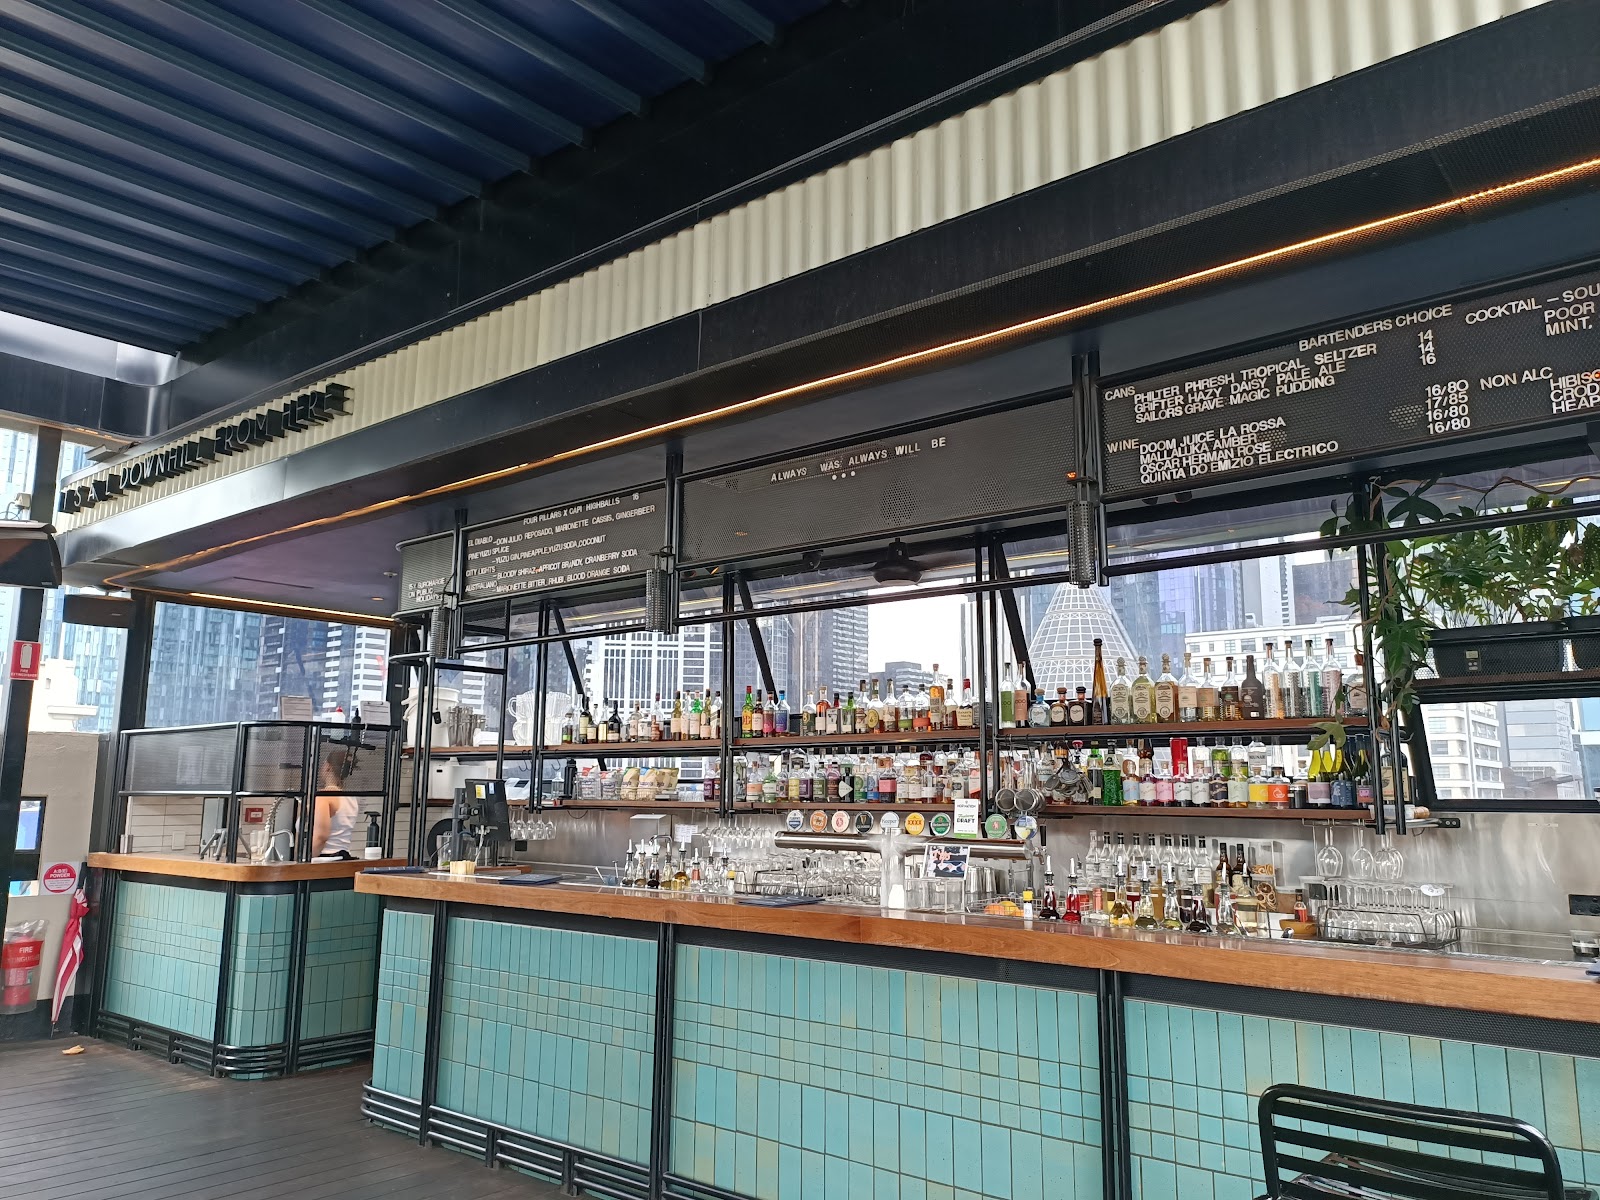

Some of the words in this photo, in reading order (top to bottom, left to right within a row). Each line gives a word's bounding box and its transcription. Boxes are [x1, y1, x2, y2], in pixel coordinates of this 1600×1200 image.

[1465, 297, 1542, 325] COCKTAIL
[1544, 301, 1595, 323] POOR
[1298, 319, 1393, 352] BARTENDERS
[1395, 303, 1453, 328] CHOICE
[1417, 329, 1434, 342] 14
[1545, 316, 1593, 337] MINT,
[1418, 341, 1434, 354] 14
[1419, 352, 1437, 365] 16
[1134, 385, 1180, 405] PHILTER
[1184, 372, 1235, 393] PHRESH
[1240, 358, 1305, 380] TROPICAL
[1314, 343, 1378, 365] SELTZER
[1480, 373, 1518, 391] NON
[1521, 366, 1553, 383] ALC
[1104, 385, 1136, 401] CANS
[1134, 395, 1185, 414] GRIFTER
[1188, 387, 1222, 403] HAZY
[1230, 378, 1267, 395] DAISY
[1276, 367, 1311, 385] PALE
[1318, 360, 1346, 377] ALE
[1425, 379, 1469, 398] 16/80
[1135, 406, 1183, 424] SAILORS
[1184, 396, 1224, 415] GRAVE
[1229, 388, 1270, 406] MAGIC
[1276, 375, 1336, 397] PUDDING
[1425, 391, 1469, 410] 17/85
[1425, 403, 1469, 422] 16/80
[1140, 438, 1177, 455] DOOM
[1180, 430, 1215, 447] JUICE
[1219, 425, 1237, 439] LA
[1240, 416, 1286, 435] ROSSA
[1427, 416, 1471, 435] 16/80
[1107, 438, 1139, 454] WINE
[1140, 442, 1209, 465] MALLALUKA
[1213, 432, 1257, 451] AMBER
[119, 438, 204, 490] DOWNHILL
[770, 467, 808, 483] ALWAYS
[820, 460, 840, 472] WAS
[848, 449, 888, 466] ALWAYS
[895, 442, 921, 456] WILL
[931, 437, 946, 449] BE
[1140, 458, 1180, 475] OSCAR
[1182, 448, 1234, 467] HERMAN
[1237, 441, 1271, 457] ROSE
[1140, 467, 1186, 484] QUINTA
[1189, 463, 1208, 476] DO
[1210, 456, 1253, 473] EMIZIO
[1258, 440, 1339, 465] ELECTRICO
[523, 516, 538, 526] FOUR
[539, 510, 562, 522] PILLARS
[563, 509, 568, 517] X
[586, 497, 620, 511] HIGHBALLS
[632, 492, 640, 501] 16
[555, 518, 589, 533] MARIONETTE
[475, 535, 493, 546] DIABLO
[492, 546, 510, 555] SPLICE
[584, 551, 620, 564] CRANBERRY
[621, 548, 638, 558] SODA
[465, 568, 477, 577] CITY
[478, 565, 496, 574] LIGHTS
[567, 571, 586, 582] BLOOD
[587, 567, 611, 579] ORANGE
[613, 564, 631, 574] SODA
